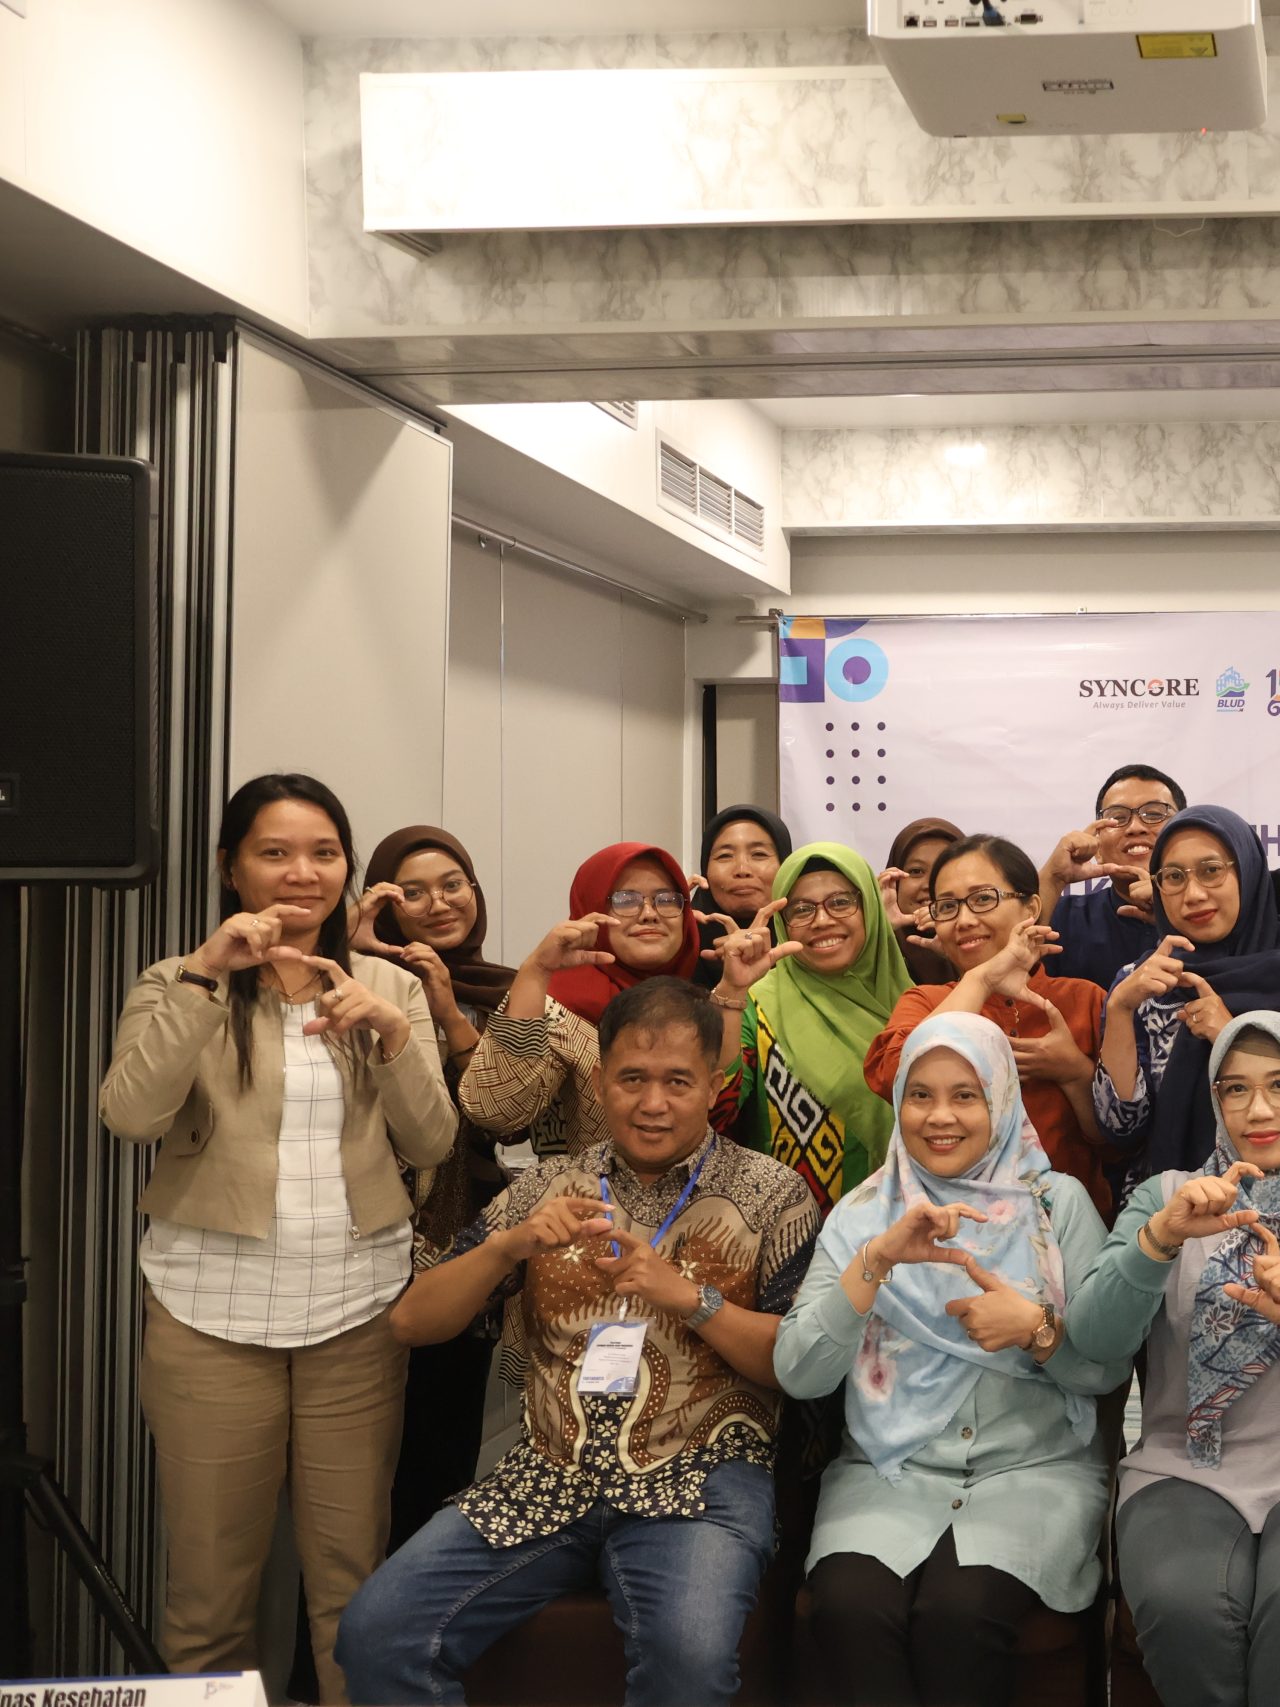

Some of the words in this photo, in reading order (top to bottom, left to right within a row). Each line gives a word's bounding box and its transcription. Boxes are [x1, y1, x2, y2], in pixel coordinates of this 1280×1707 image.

[1079, 678, 1200, 698] SYNCORE
[1093, 701, 1125, 711] Always
[1127, 701, 1159, 709] Deliver
[1161, 700, 1187, 708] Value
[1217, 699, 1245, 708] BLUD
[42, 1686, 147, 1707] Kesehatan
